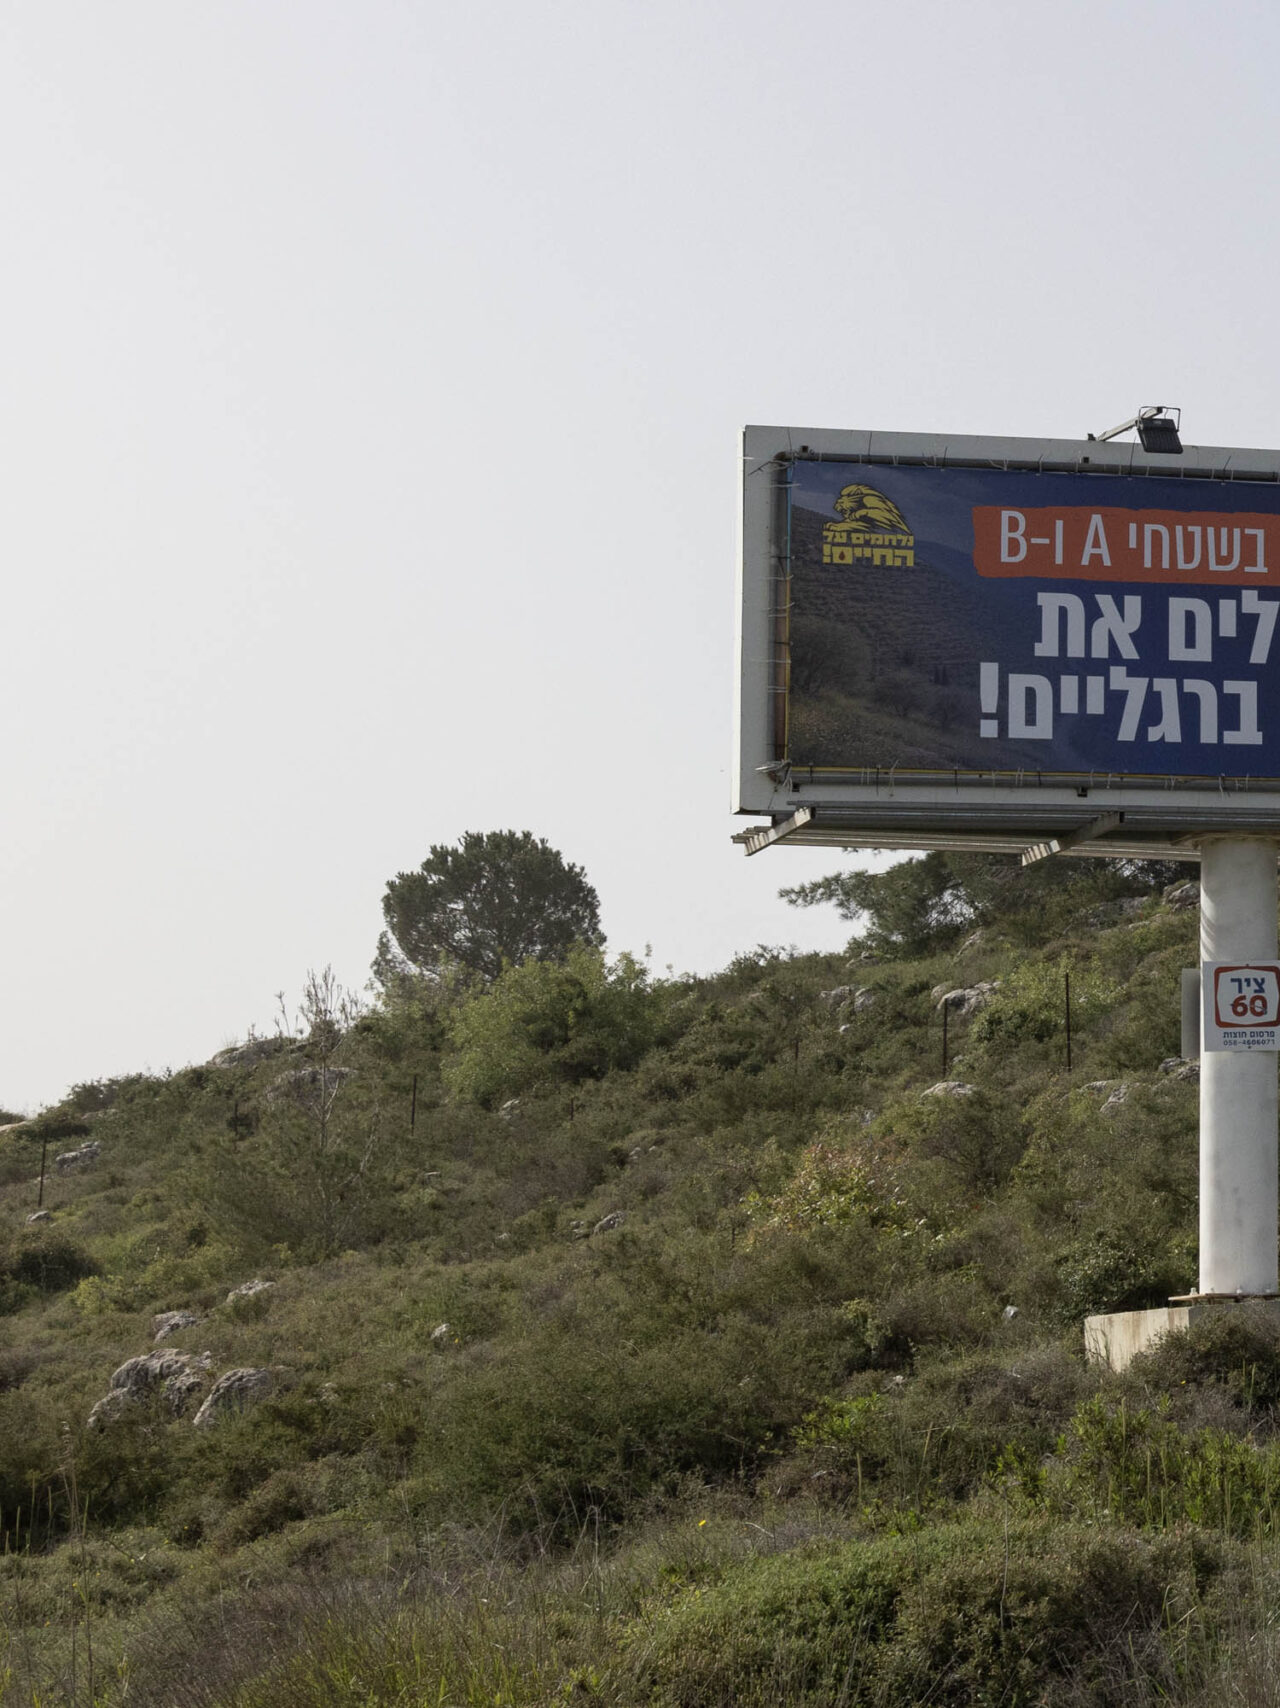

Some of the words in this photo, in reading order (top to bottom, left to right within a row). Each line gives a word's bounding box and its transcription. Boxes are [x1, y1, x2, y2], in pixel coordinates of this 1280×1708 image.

[822, 530, 848, 544] על
[851, 532, 915, 547] נלחמים
[1080, 513, 1112, 567] A
[1128, 522, 1269, 574] בשטחי
[822, 543, 915, 567] החיים!
[1034, 592, 1142, 660] את
[979, 661, 1263, 746] ברגליים!
[1230, 977, 1266, 995] ציר
[1231, 995, 1268, 1018] 60
[1222, 1031, 1247, 1040] חוצות
[1249, 1030, 1276, 1039] פרסום
